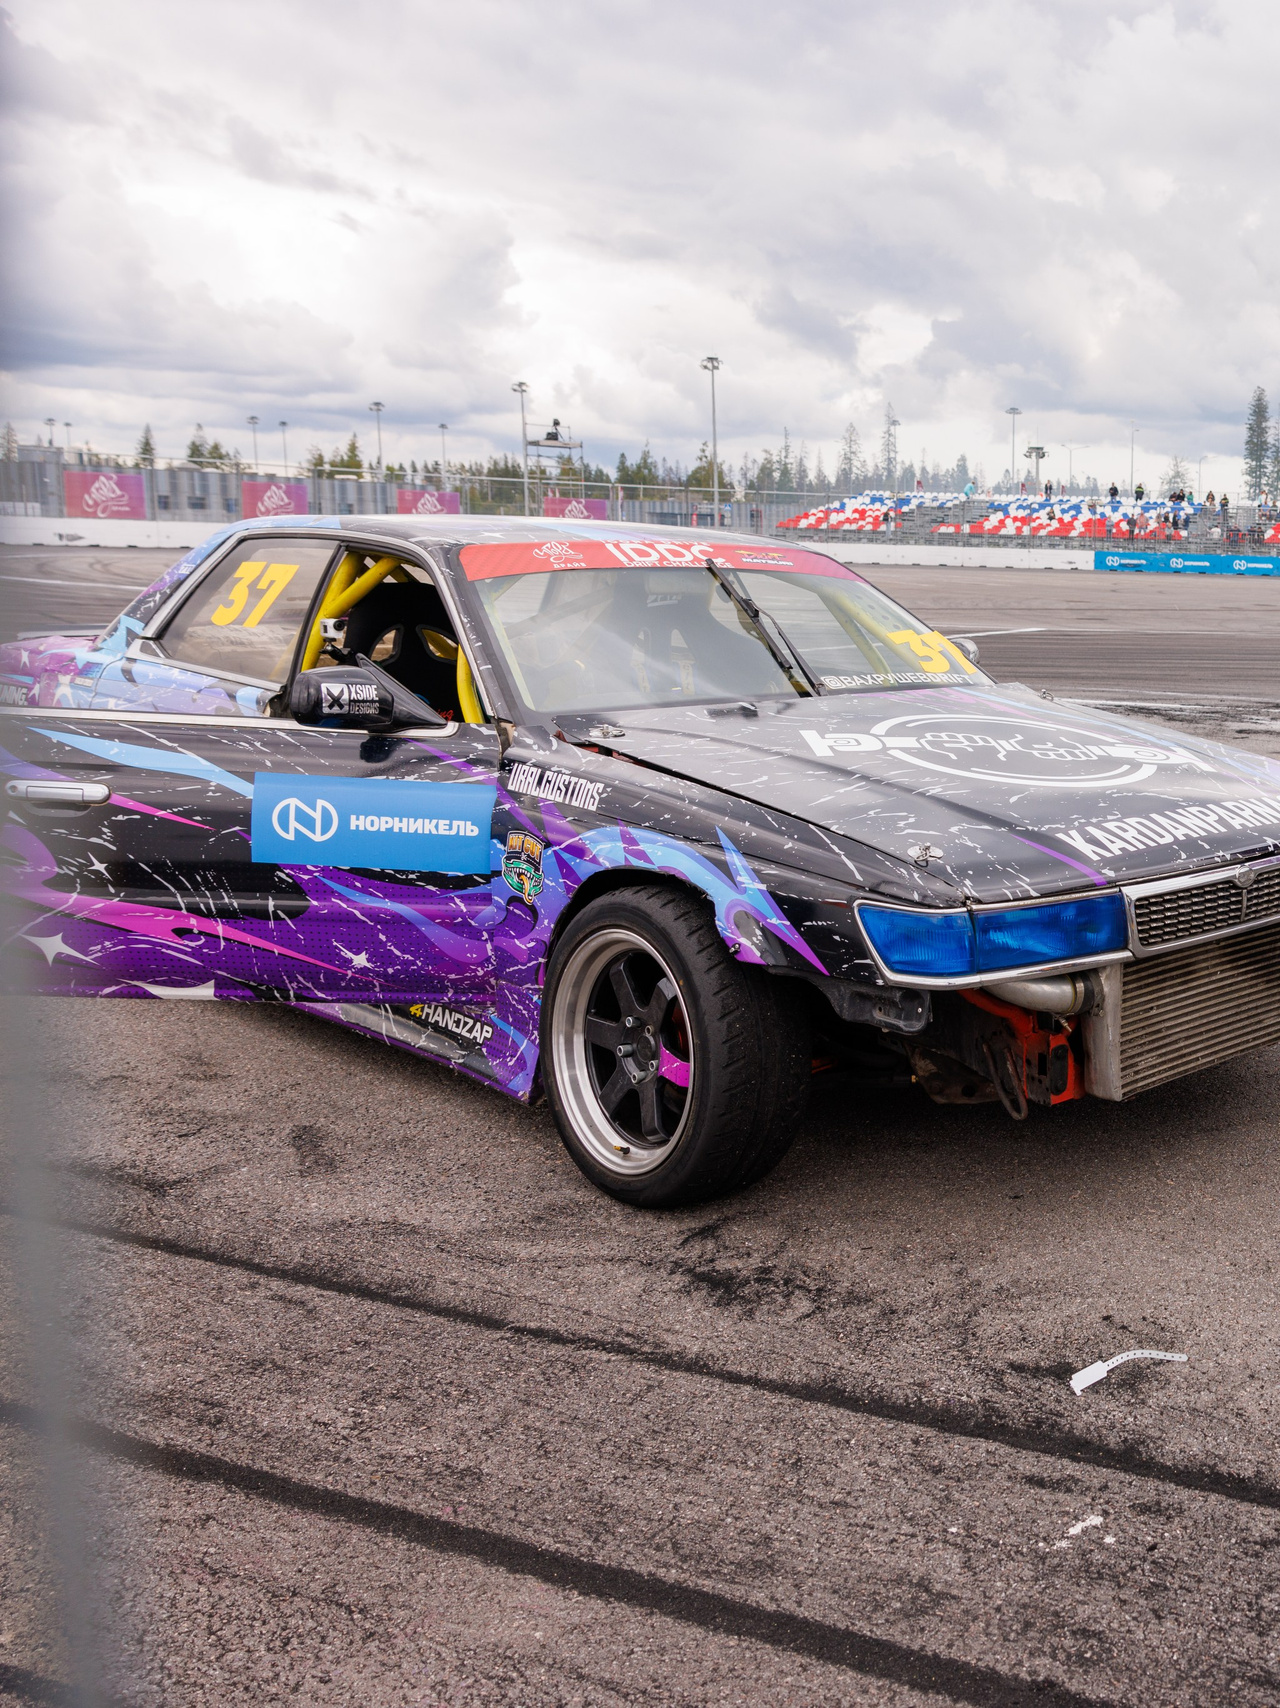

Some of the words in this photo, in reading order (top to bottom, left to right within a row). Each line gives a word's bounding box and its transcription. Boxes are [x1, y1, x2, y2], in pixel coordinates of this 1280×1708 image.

[604, 543, 726, 563] IDDC
[623, 560, 661, 569] DRIFT
[210, 561, 301, 629] 37
[886, 629, 977, 675] 37
[348, 684, 379, 701] XSIDE
[349, 702, 380, 715] DESIGNS
[349, 814, 480, 837] НОРНИКЕЛЬ
[508, 833, 524, 852] KIT
[523, 836, 542, 862] CUT
